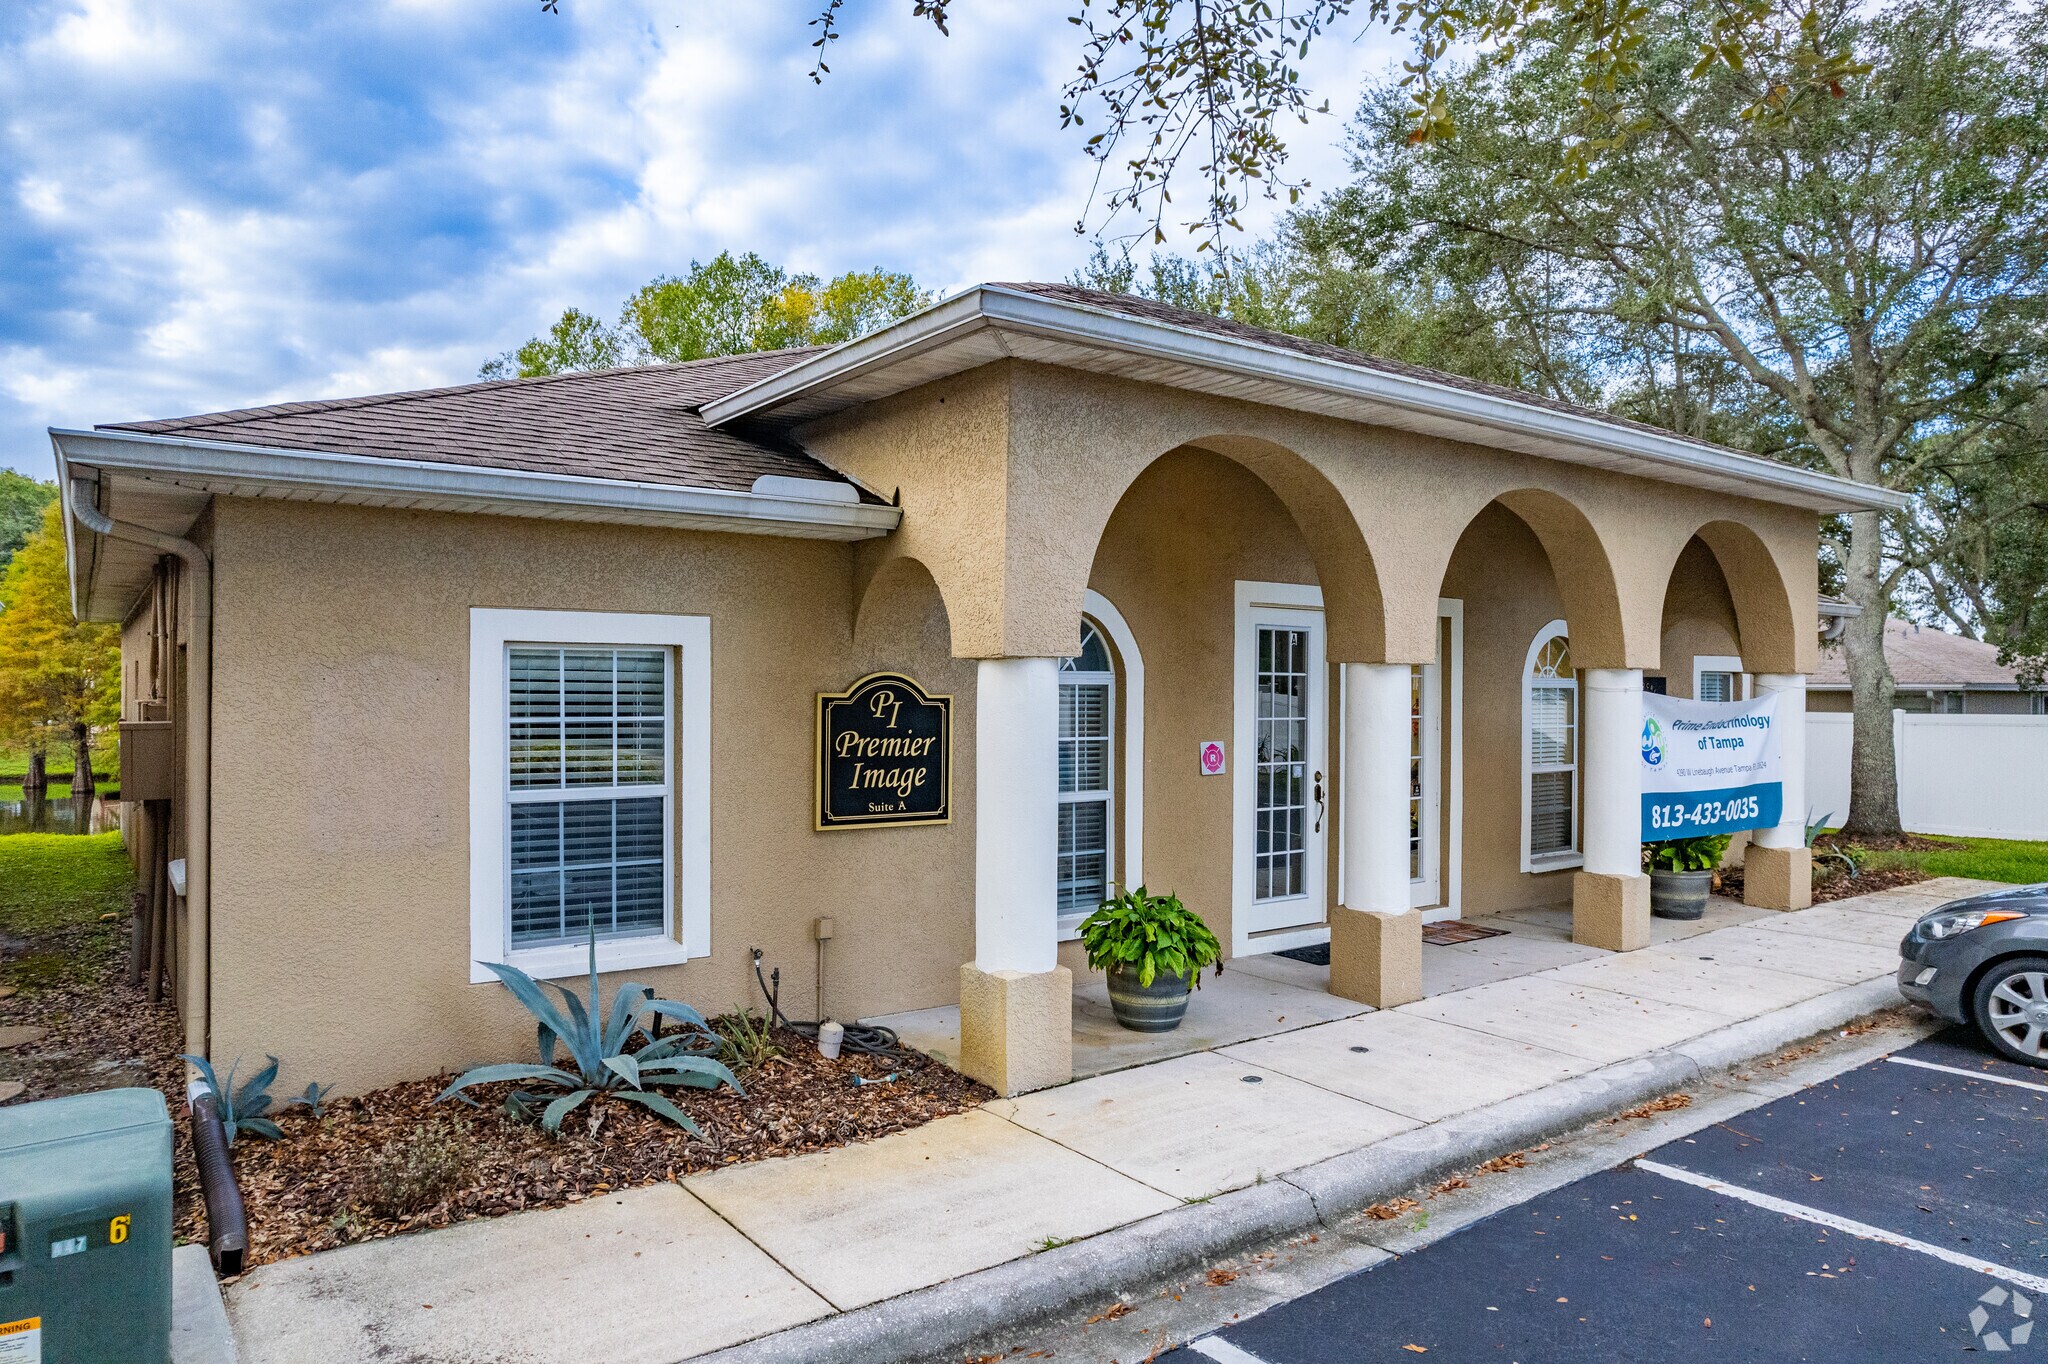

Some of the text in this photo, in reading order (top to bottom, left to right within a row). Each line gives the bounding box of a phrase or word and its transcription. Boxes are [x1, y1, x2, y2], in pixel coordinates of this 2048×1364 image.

[1290, 632, 1298, 646] A
[1672, 714, 1770, 731] Prime Endocrinology
[835, 729, 937, 758] Premier
[1698, 736, 1745, 751] of Tampa
[1210, 754, 1216, 762] R
[1715, 766, 1734, 774] Avenue
[1734, 764, 1753, 772] Tampa
[848, 762, 927, 798] Image
[868, 801, 907, 812] Suite A
[1652, 796, 1759, 829] 813-433-0035
[109, 1215, 128, 1244] 6
